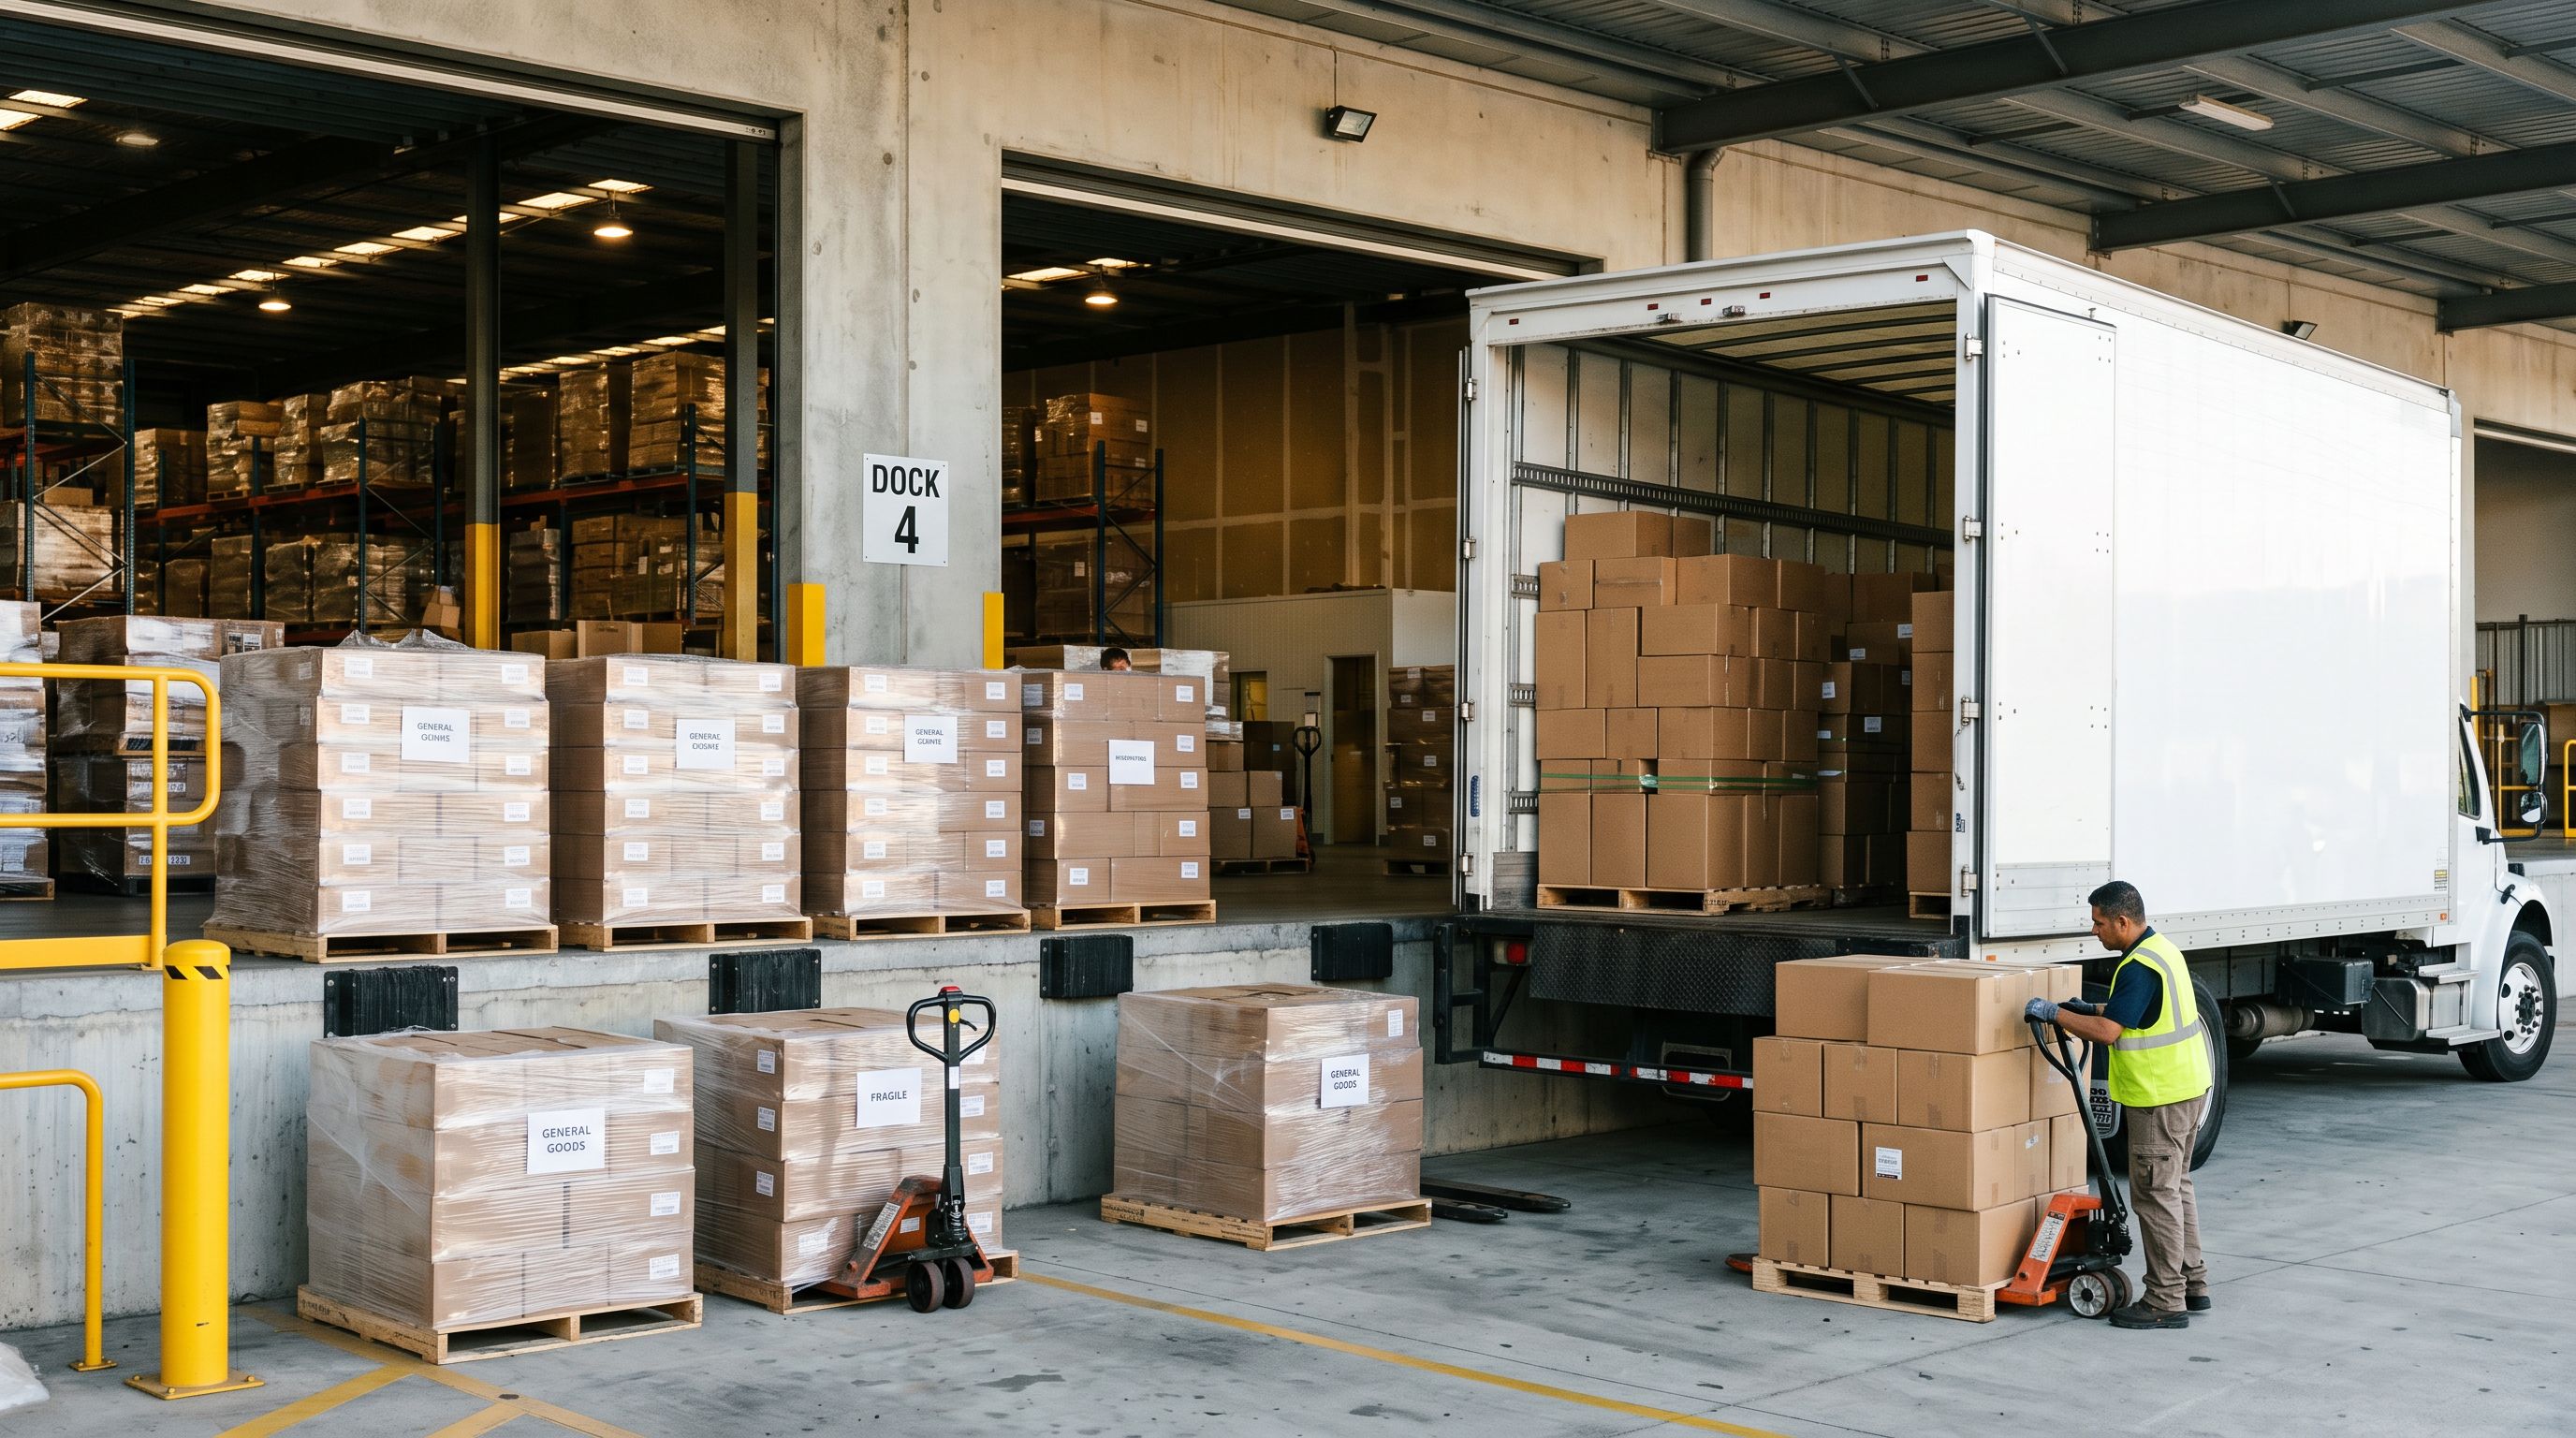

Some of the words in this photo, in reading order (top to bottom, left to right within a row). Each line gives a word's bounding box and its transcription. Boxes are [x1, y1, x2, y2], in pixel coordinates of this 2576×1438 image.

[872, 464, 940, 498] DOCK
[894, 506, 919, 553] 4
[417, 722, 454, 732] GENERAL
[1330, 1067, 1361, 1078] GENERAL
[1333, 1079, 1357, 1091] GOODS
[871, 1090, 908, 1102] FRAGILE
[542, 1124, 592, 1138] GENERAL
[547, 1140, 586, 1153] GOODS
